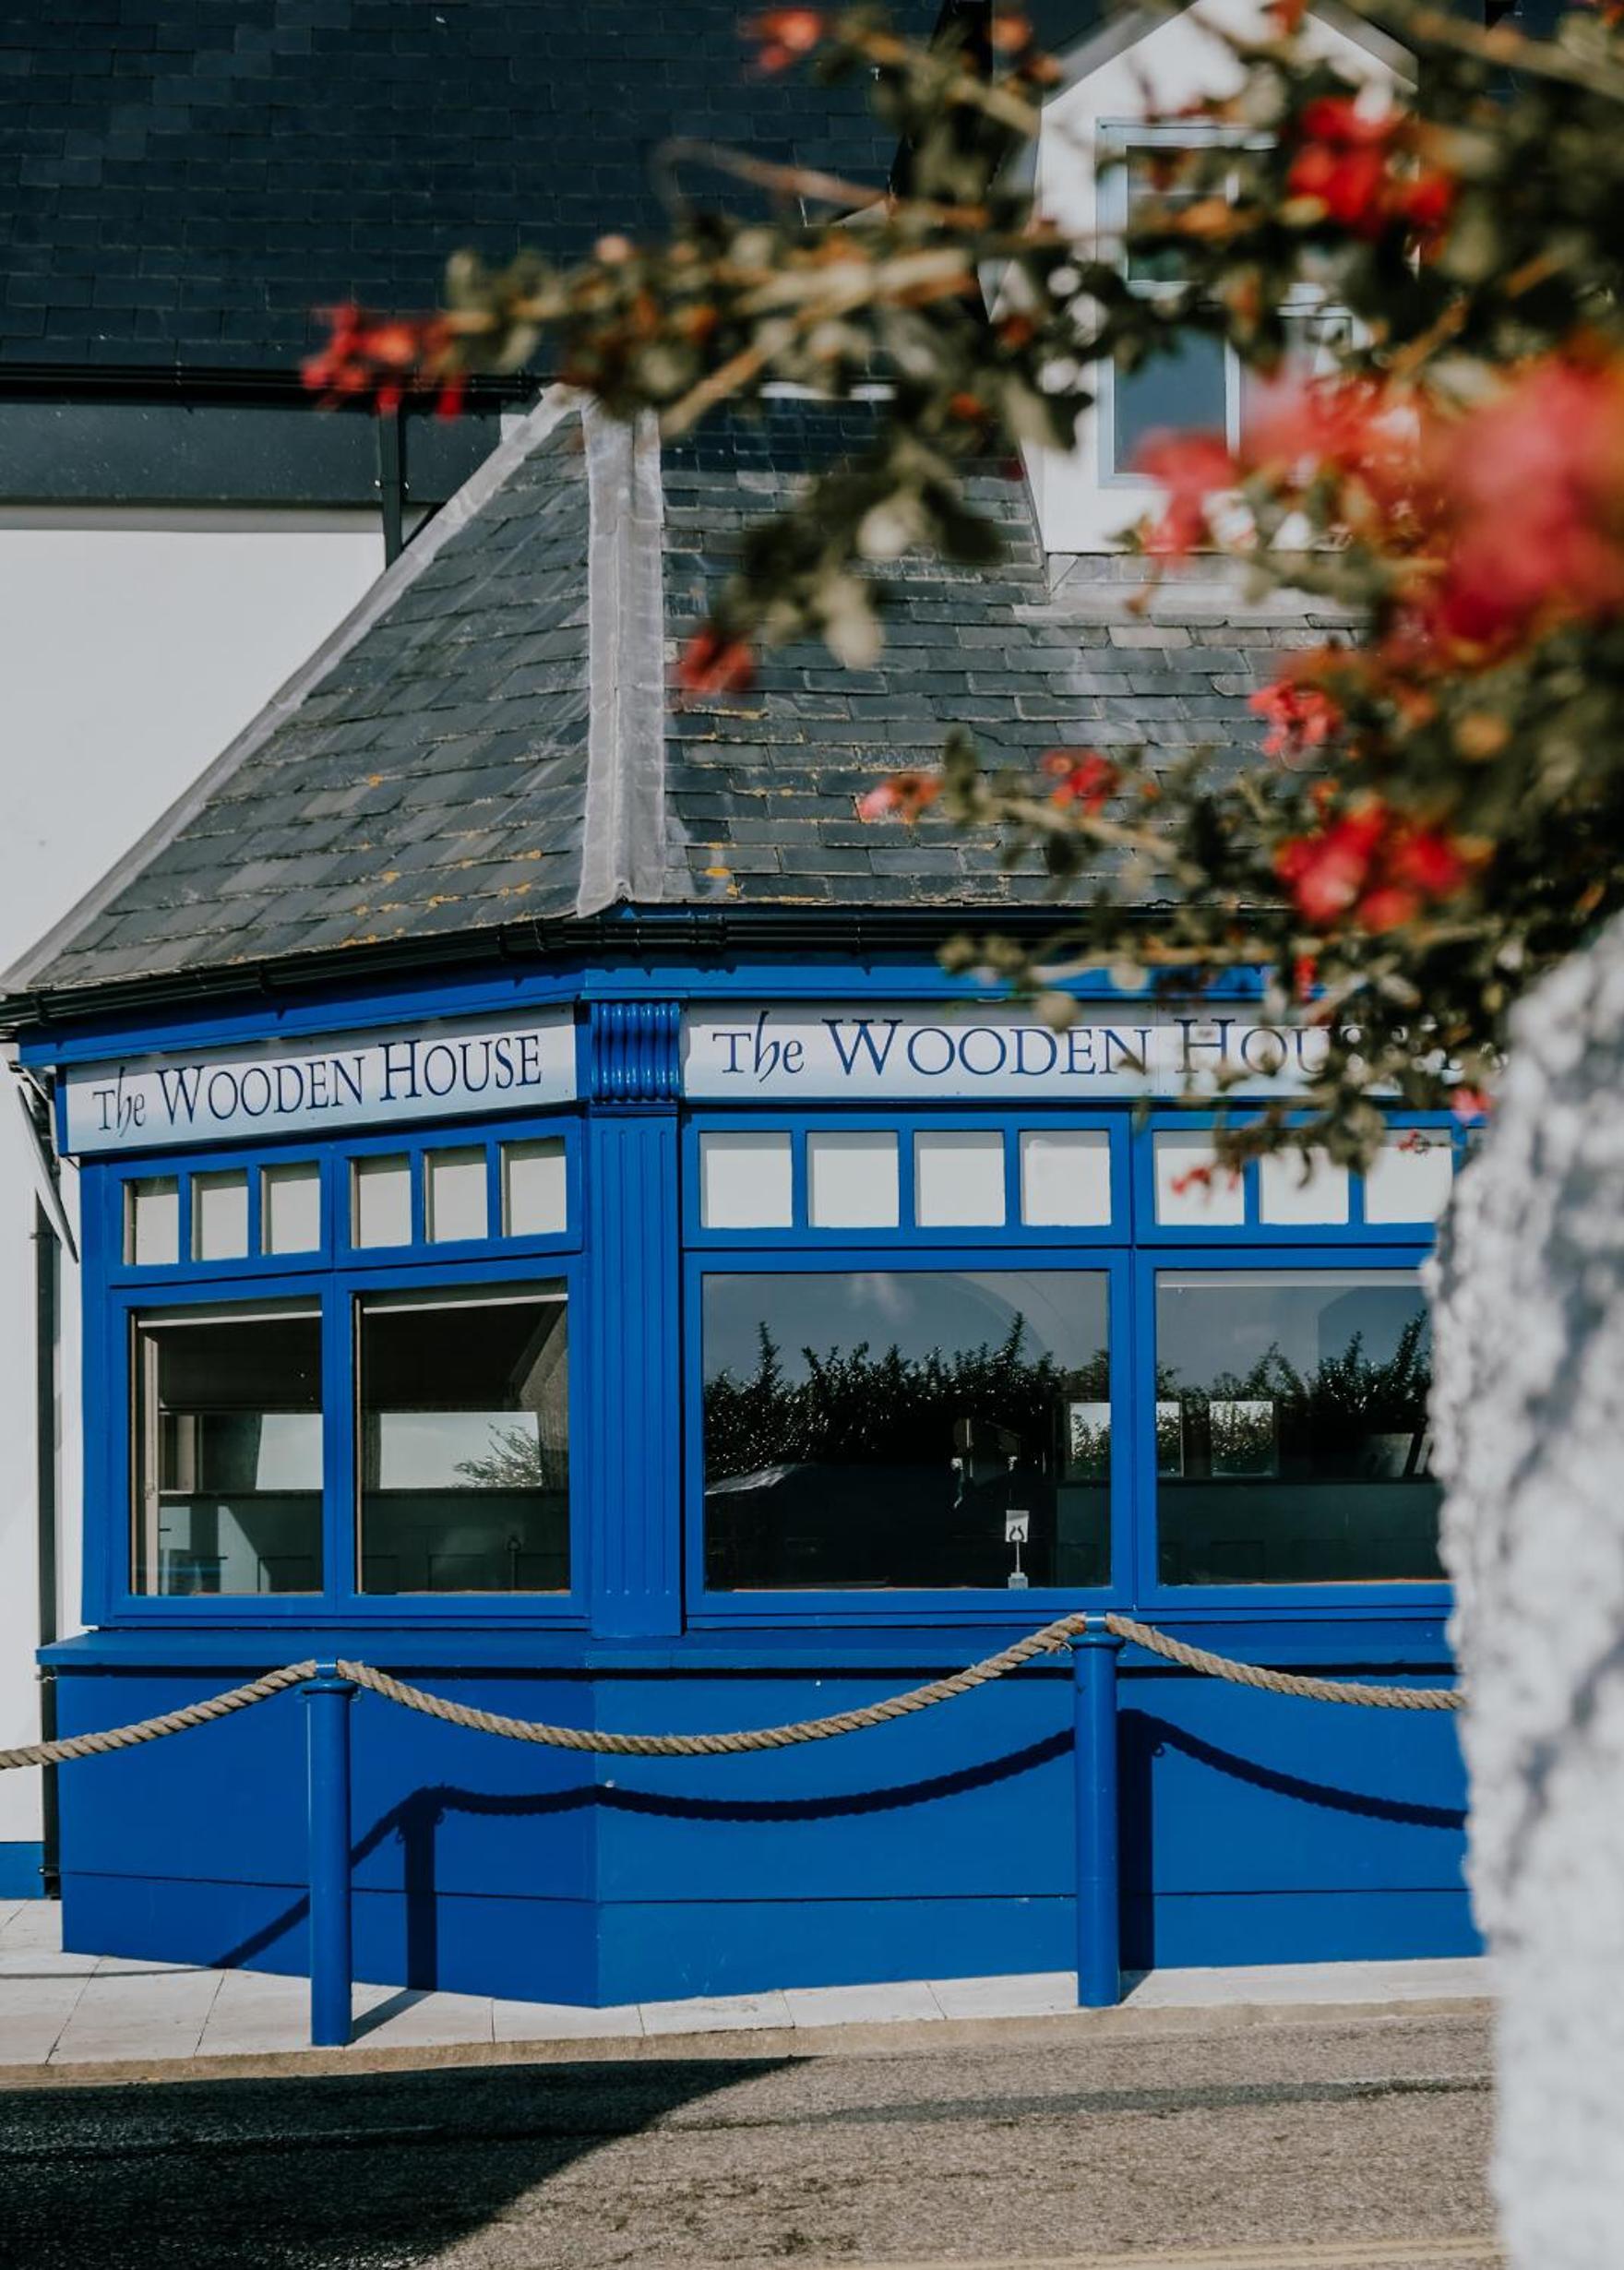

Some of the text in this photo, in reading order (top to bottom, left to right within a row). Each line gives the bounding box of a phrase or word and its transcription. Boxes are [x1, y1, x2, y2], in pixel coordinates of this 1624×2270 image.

[92, 1034, 543, 1137] The WOODEN HOUSE
[712, 1010, 805, 1083] The
[821, 1019, 1152, 1076] WOODEN
